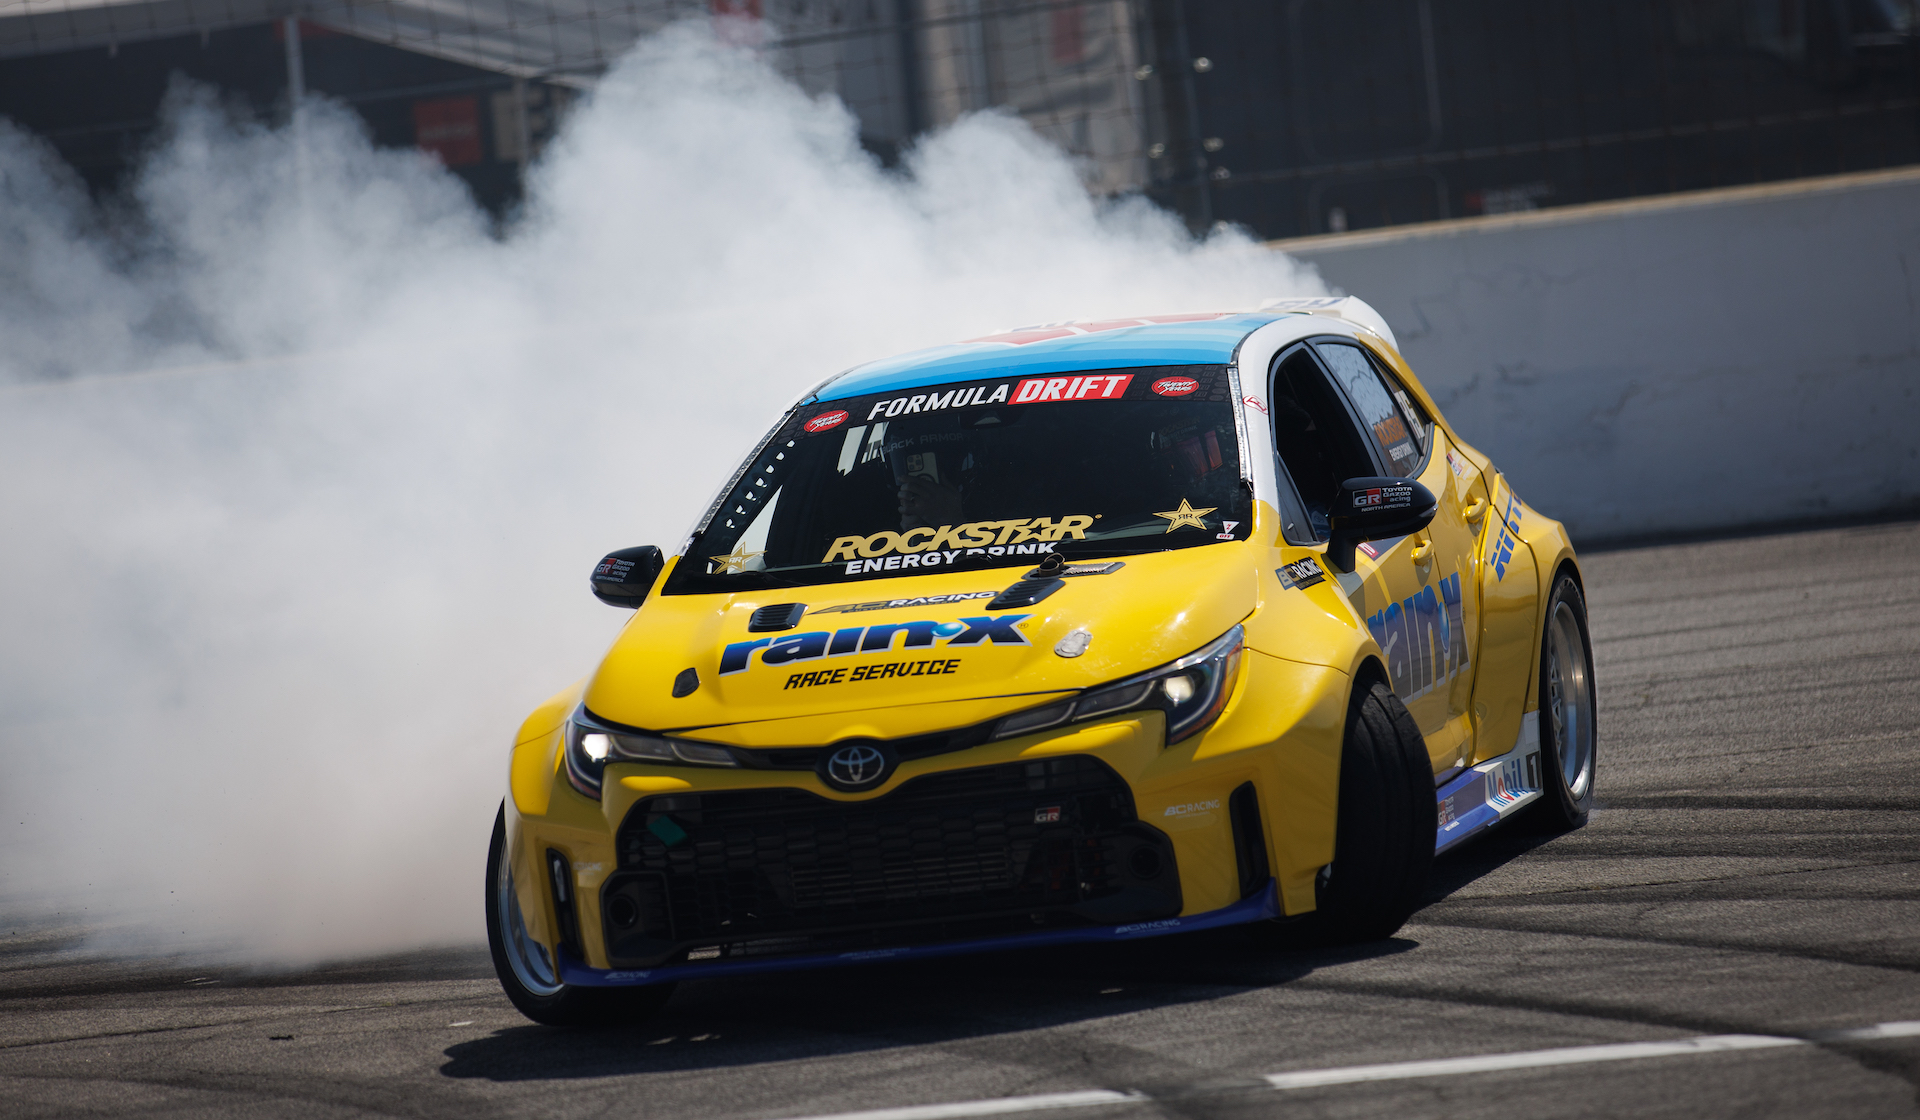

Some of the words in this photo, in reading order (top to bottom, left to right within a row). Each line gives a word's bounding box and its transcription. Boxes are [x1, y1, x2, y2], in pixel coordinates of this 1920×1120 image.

[867, 384, 1010, 421] FORMULA
[1016, 376, 1127, 402] DRIFT
[920, 432, 965, 445] ARMOR
[1355, 494, 1380, 506] GR
[1384, 502, 1411, 510] AMERICA
[821, 515, 1095, 563] ROCKSTAR
[597, 563, 612, 574] GR
[845, 550, 962, 575] ENERGY
[784, 668, 849, 690] RACE
[849, 659, 962, 683] SERVICE
[1487, 758, 1529, 807] Mobil
[1036, 812, 1060, 822] GR
